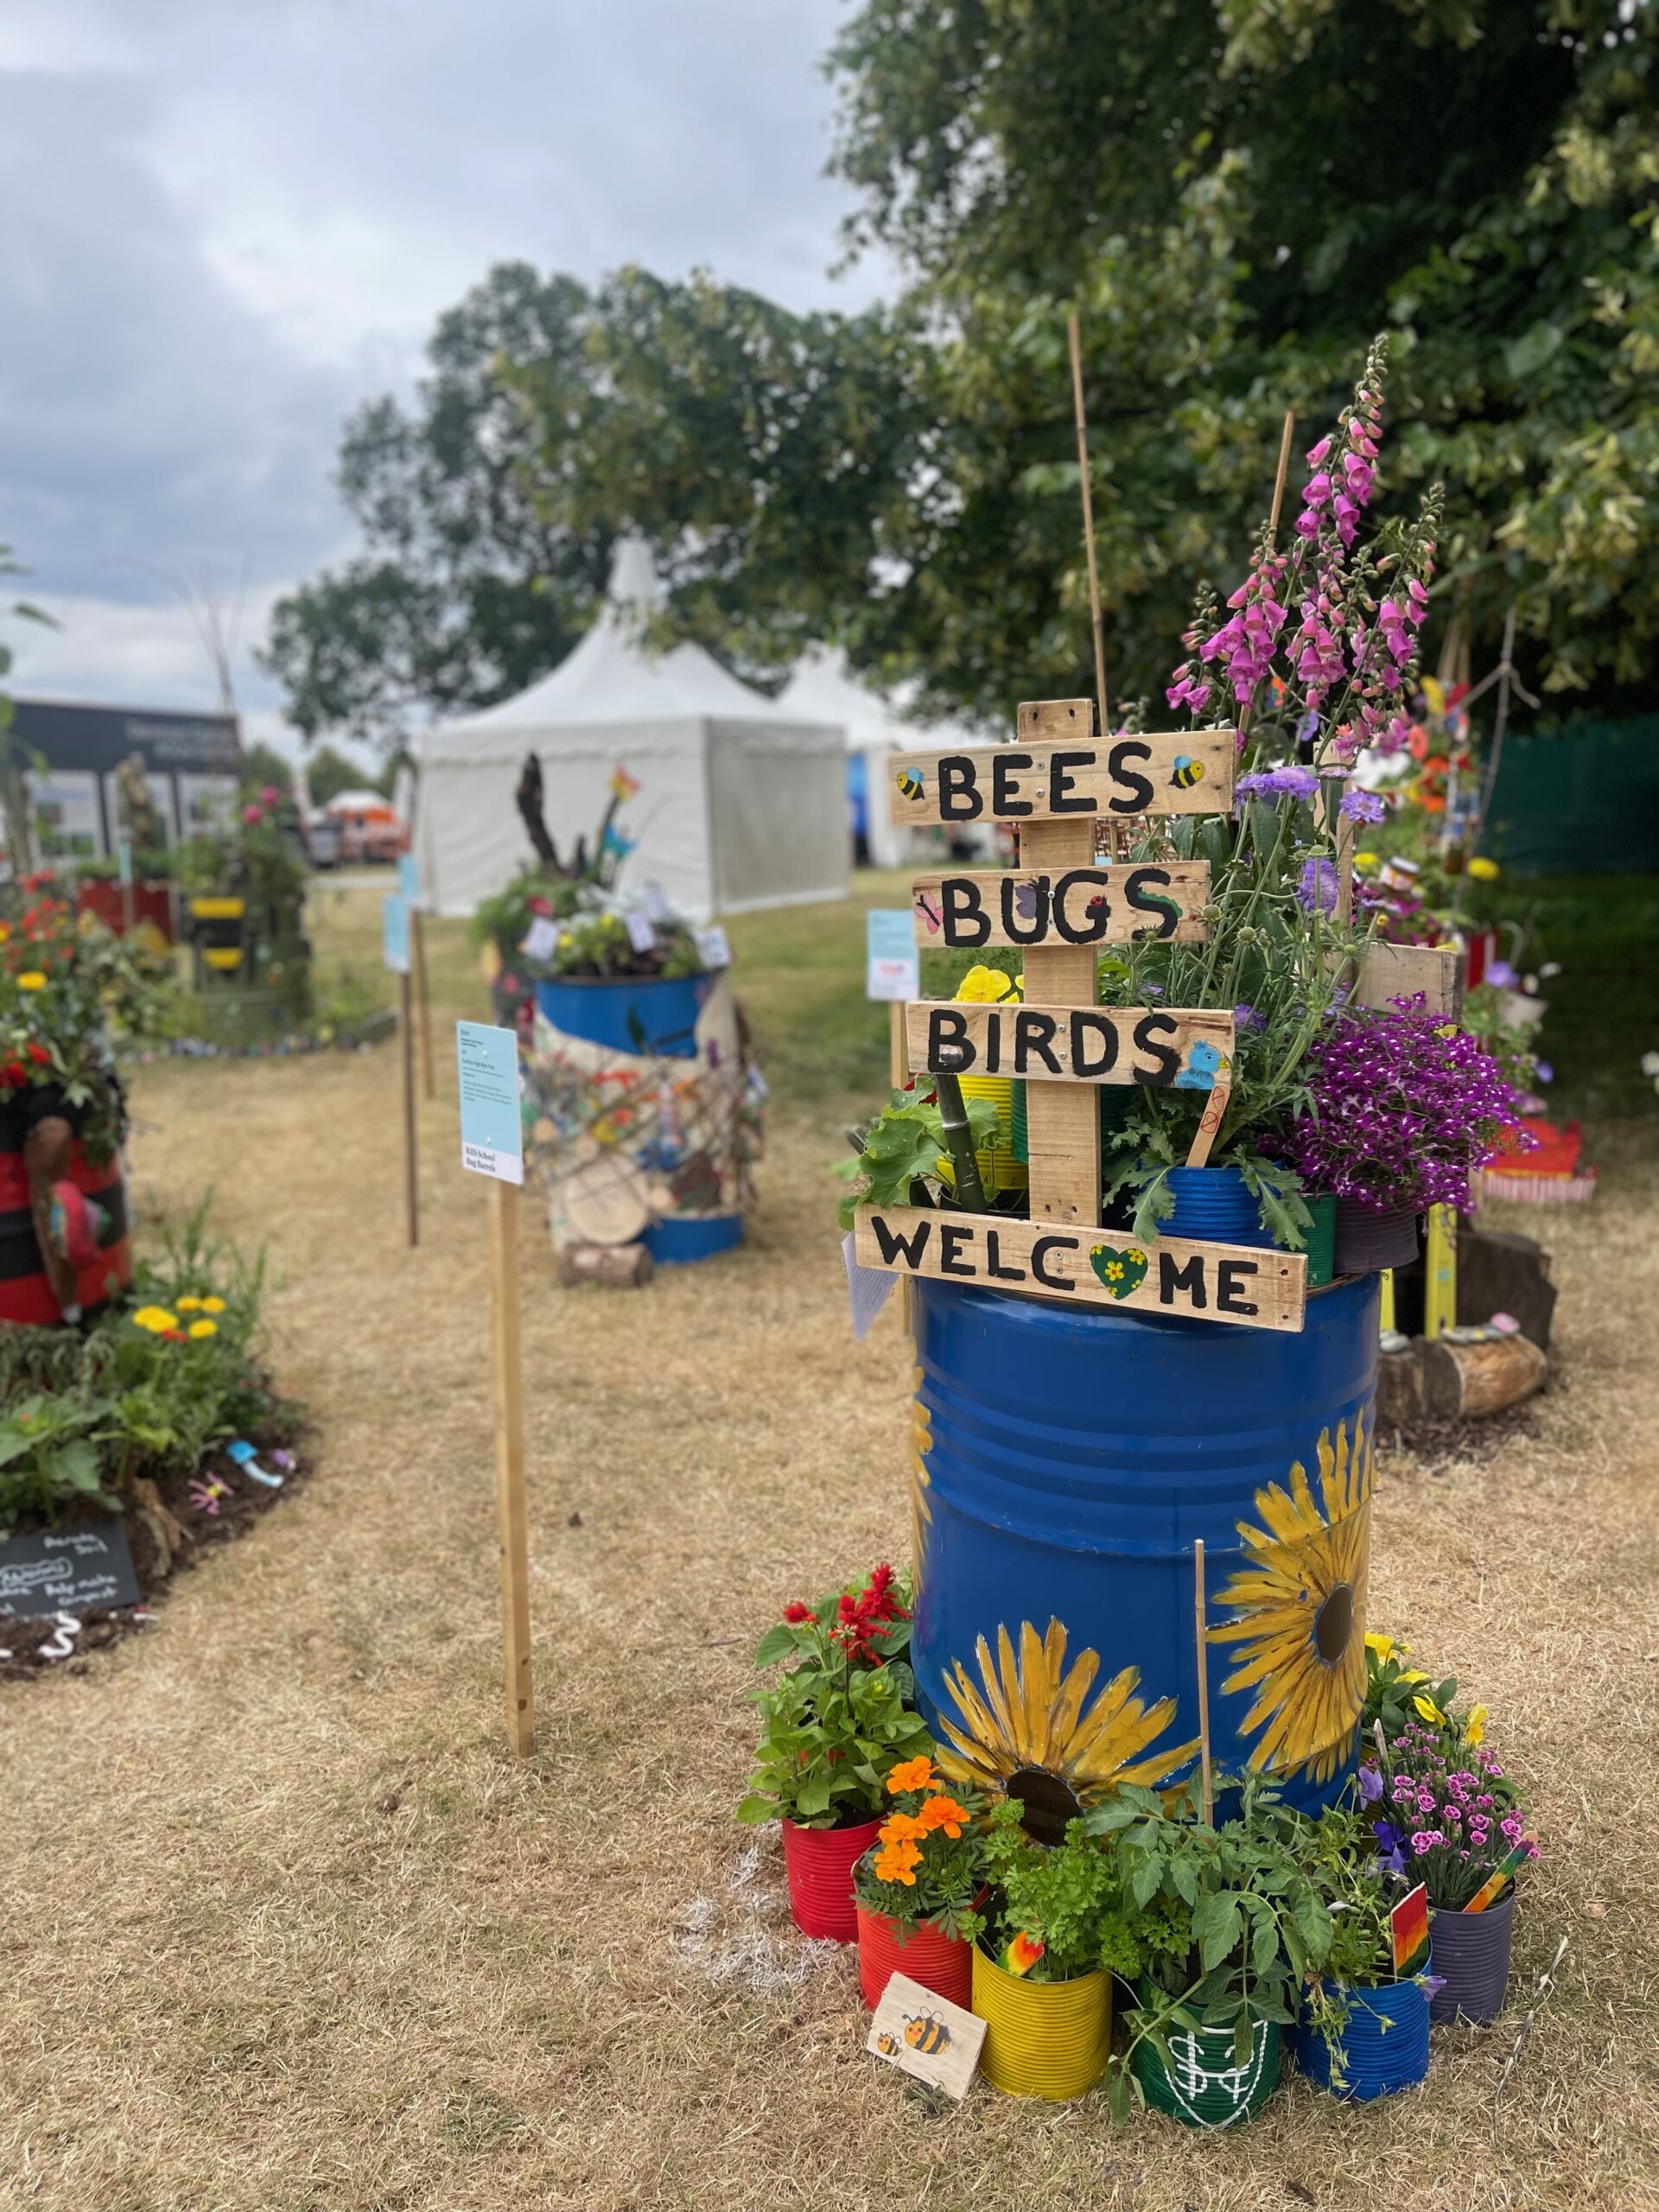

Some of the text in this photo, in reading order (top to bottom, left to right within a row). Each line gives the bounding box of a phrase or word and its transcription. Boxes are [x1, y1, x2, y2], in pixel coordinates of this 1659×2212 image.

[938, 741, 1154, 821] BEES
[941, 868, 1181, 948] BUGS
[927, 1008, 1182, 1087] BIRDS
[466, 1147, 496, 1162] RHS School
[467, 1157, 496, 1173] Bug Barrels
